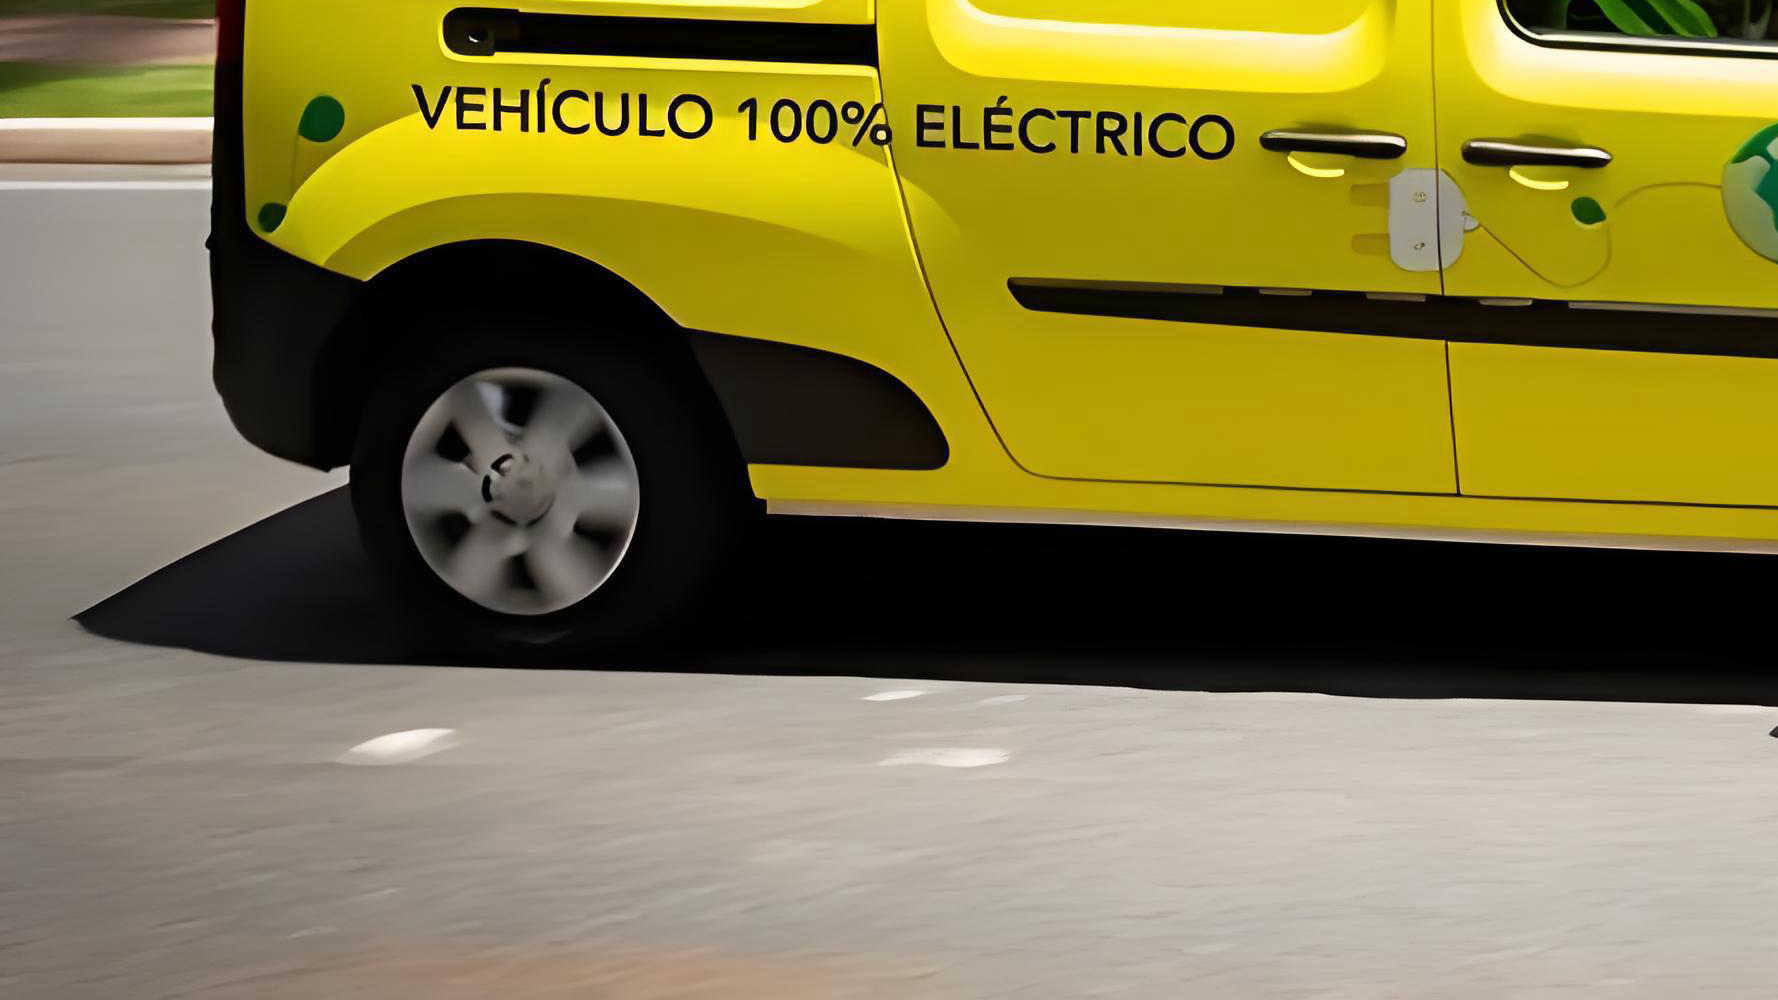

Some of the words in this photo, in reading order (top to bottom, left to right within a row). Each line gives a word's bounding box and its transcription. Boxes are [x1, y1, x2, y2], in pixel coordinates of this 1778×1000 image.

[411, 77, 714, 141] VEHÍCULO
[737, 97, 893, 147] 100%
[915, 95, 1236, 161] ELÉCTRICO
